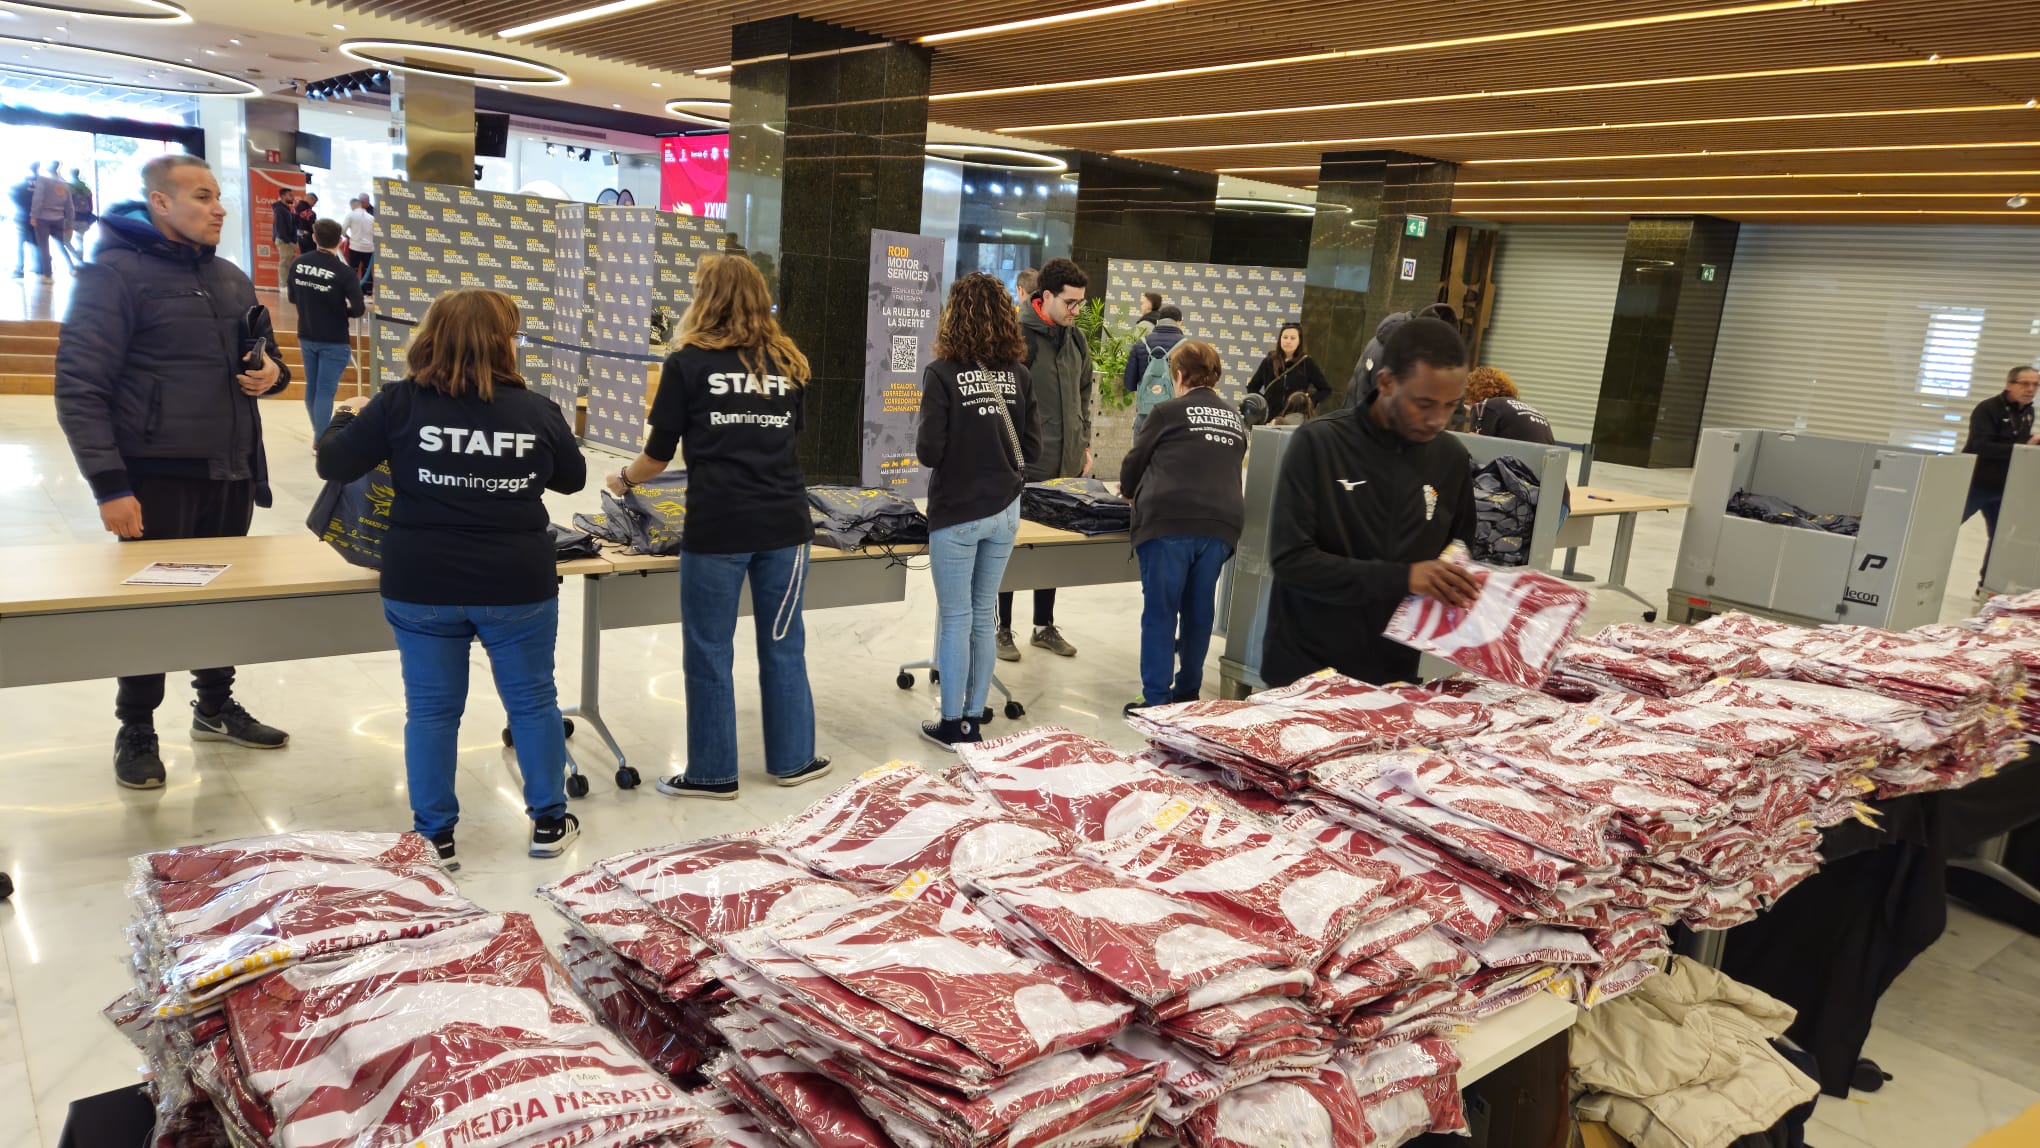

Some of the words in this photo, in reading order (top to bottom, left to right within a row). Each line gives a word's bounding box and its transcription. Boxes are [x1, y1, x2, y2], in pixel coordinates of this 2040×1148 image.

[888, 246, 909, 257] RODI
[888, 257, 919, 270] MOTOR
[296, 264, 336, 280] STAFF
[888, 268, 928, 281] SERVICES
[882, 306, 891, 316] LA
[892, 307, 919, 317] RULETA
[921, 309, 930, 318] DE
[888, 318, 897, 327] LA
[898, 318, 925, 328] SUERTE
[708, 372, 790, 396] STAFF
[956, 370, 1006, 385] CORER
[958, 383, 1016, 396] VALIETES
[1186, 406, 1234, 420] CORRER
[419, 426, 536, 458] STAFF
[443, 1098, 548, 1148] MEDIA
